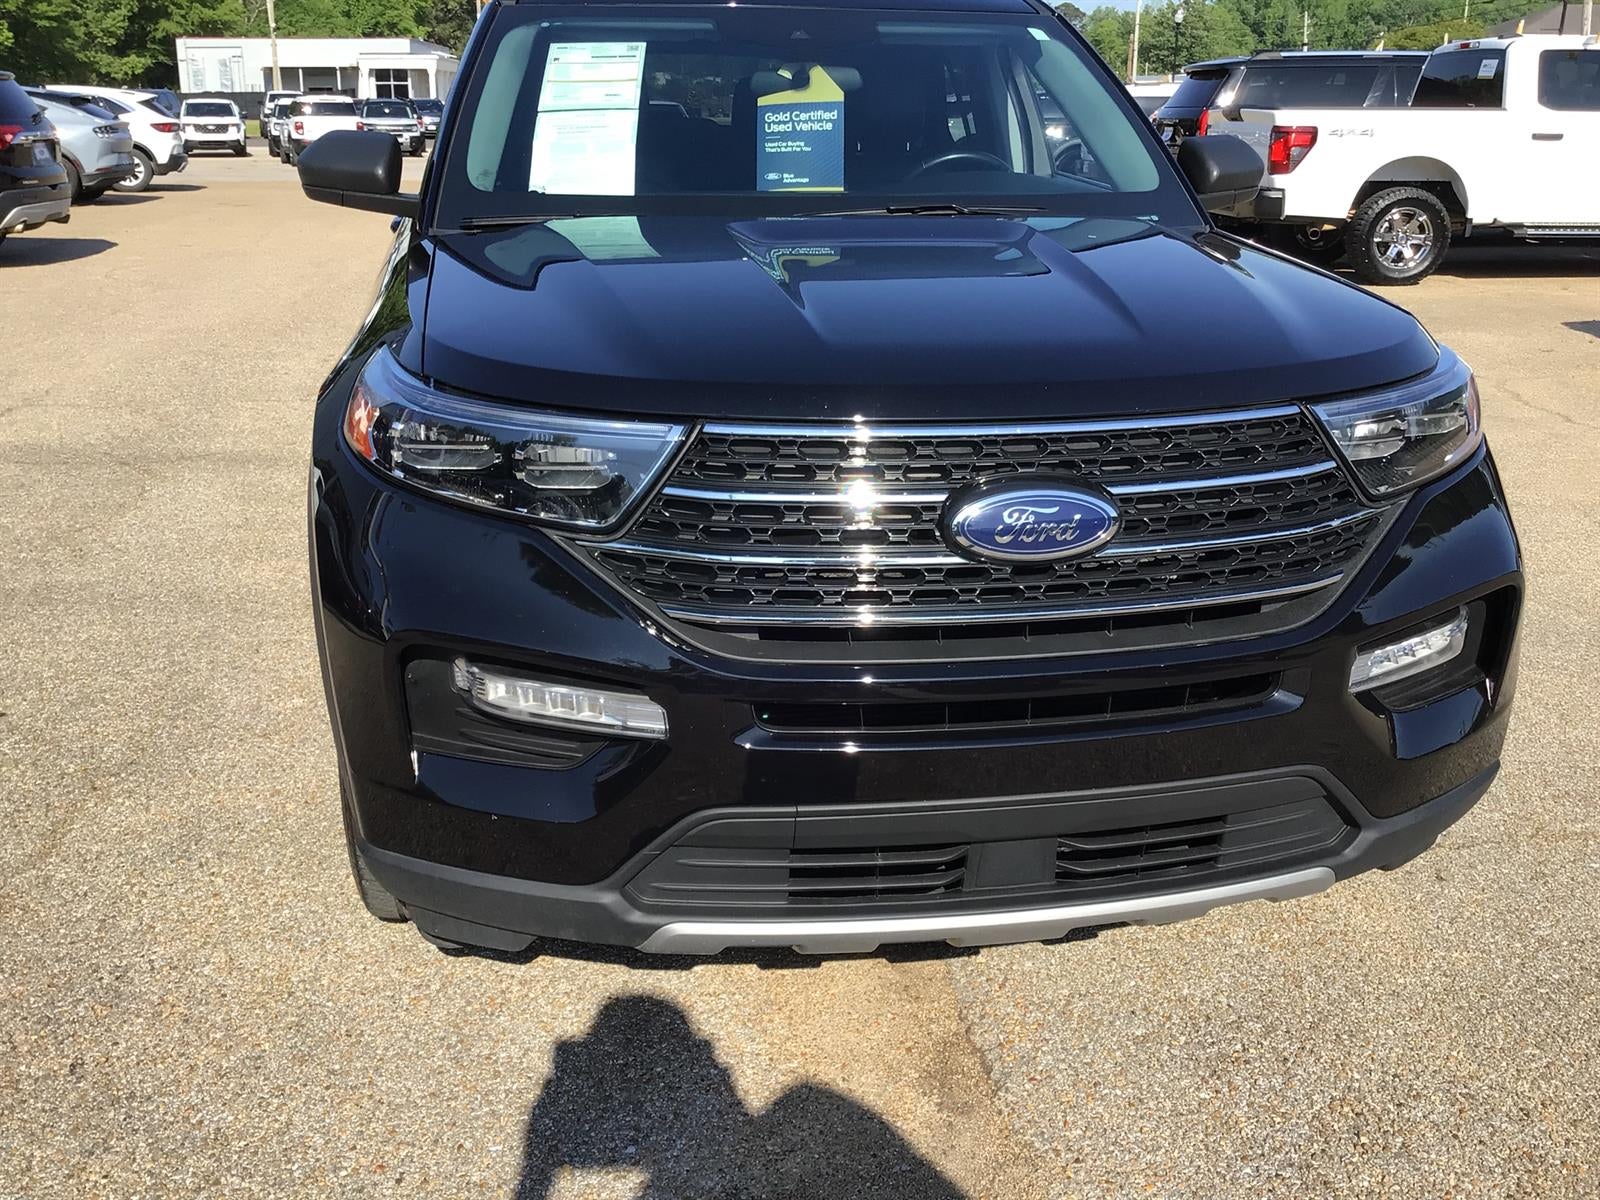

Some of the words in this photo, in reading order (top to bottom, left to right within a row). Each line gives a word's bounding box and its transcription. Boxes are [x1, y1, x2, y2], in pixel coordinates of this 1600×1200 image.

[764, 112, 790, 122] Gold
[792, 110, 838, 120] Certified
[764, 122, 792, 132] Used
[794, 121, 833, 131] Vehicle
[994, 505, 1082, 544] Ford
